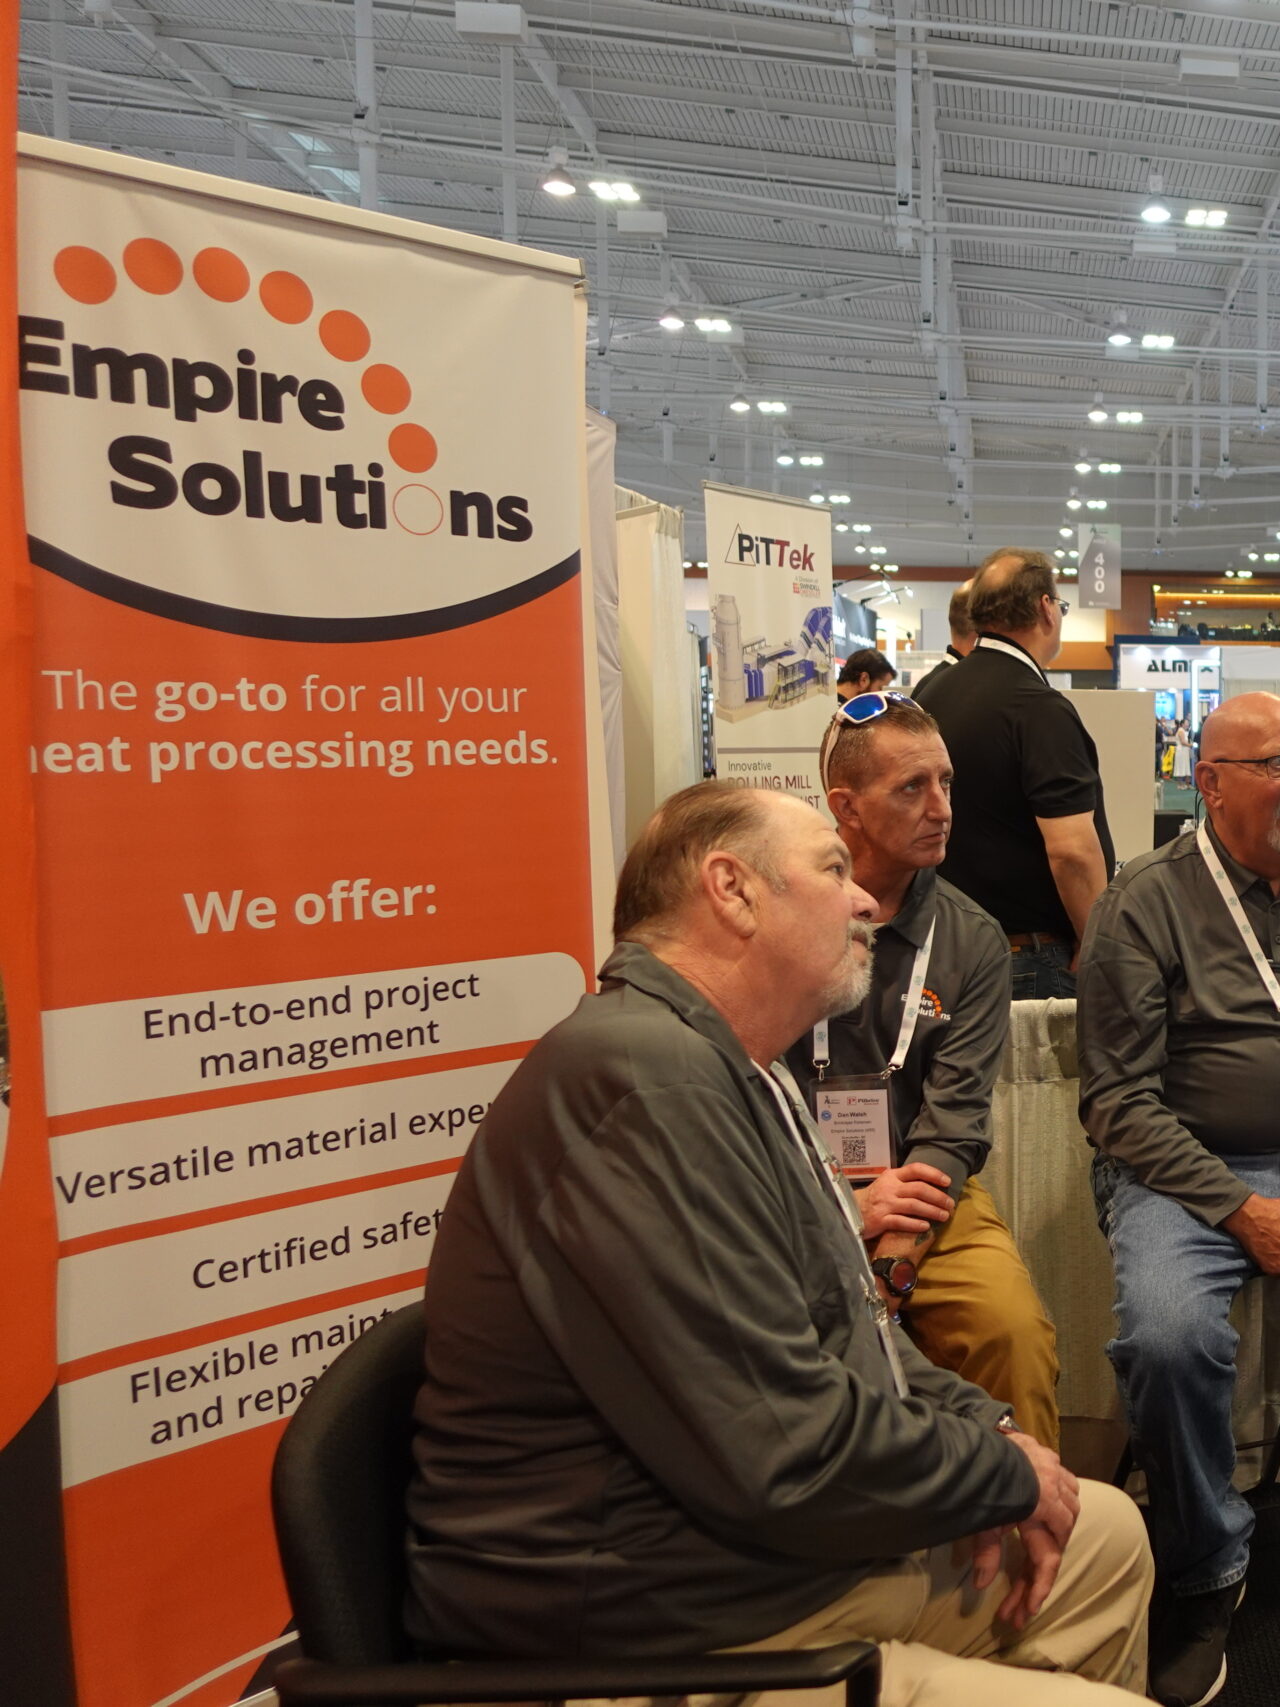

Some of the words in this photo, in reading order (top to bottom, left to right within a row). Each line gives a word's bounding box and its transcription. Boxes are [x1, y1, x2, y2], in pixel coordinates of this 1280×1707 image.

[18, 315, 346, 432] Empire
[108, 435, 533, 542] Solutions
[738, 533, 815, 572] PiTTek
[42, 670, 138, 711] The
[155, 676, 287, 722] go-to
[301, 674, 359, 711] for
[380, 676, 425, 711] all
[437, 684, 527, 722] your
[150, 730, 413, 783] processing
[427, 729, 558, 767] needs.
[728, 760, 772, 771] Innovative
[785, 775, 812, 789] MILL
[184, 889, 278, 934] We
[294, 877, 438, 925] offer:
[143, 986, 352, 1040] End-to-end
[364, 972, 481, 1012] project
[200, 1019, 440, 1079] management
[56, 1145, 234, 1204] Versatile
[248, 1113, 398, 1167] material
[408, 1102, 492, 1137] expe
[192, 1226, 352, 1290] Certified
[131, 1335, 278, 1403] Flexible
[150, 1397, 223, 1446] and
[237, 1364, 328, 1418] repa
